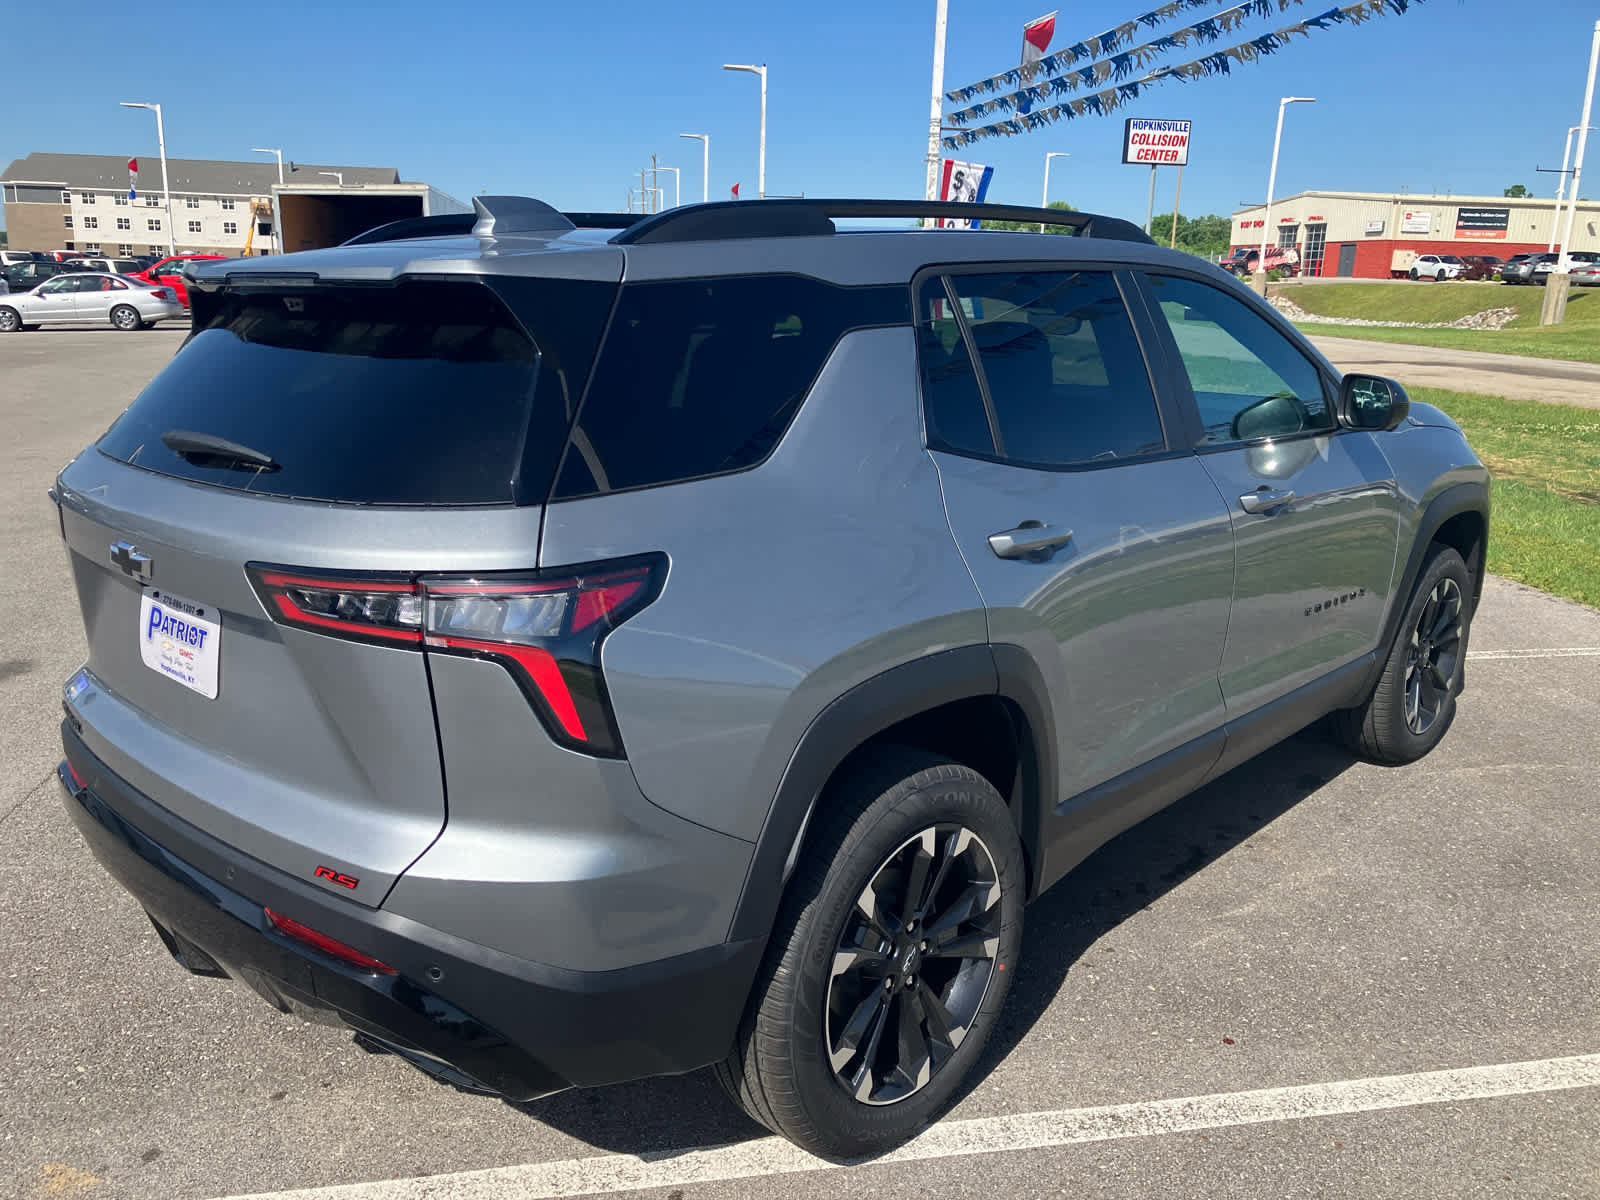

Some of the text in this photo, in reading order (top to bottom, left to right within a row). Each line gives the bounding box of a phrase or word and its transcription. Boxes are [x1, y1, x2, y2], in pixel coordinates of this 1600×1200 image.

[1132, 120, 1189, 132] HOPKINSVILLE
[1131, 133, 1187, 147] COLLISION
[1136, 148, 1179, 162] CENTER
[314, 865, 360, 889] RS
